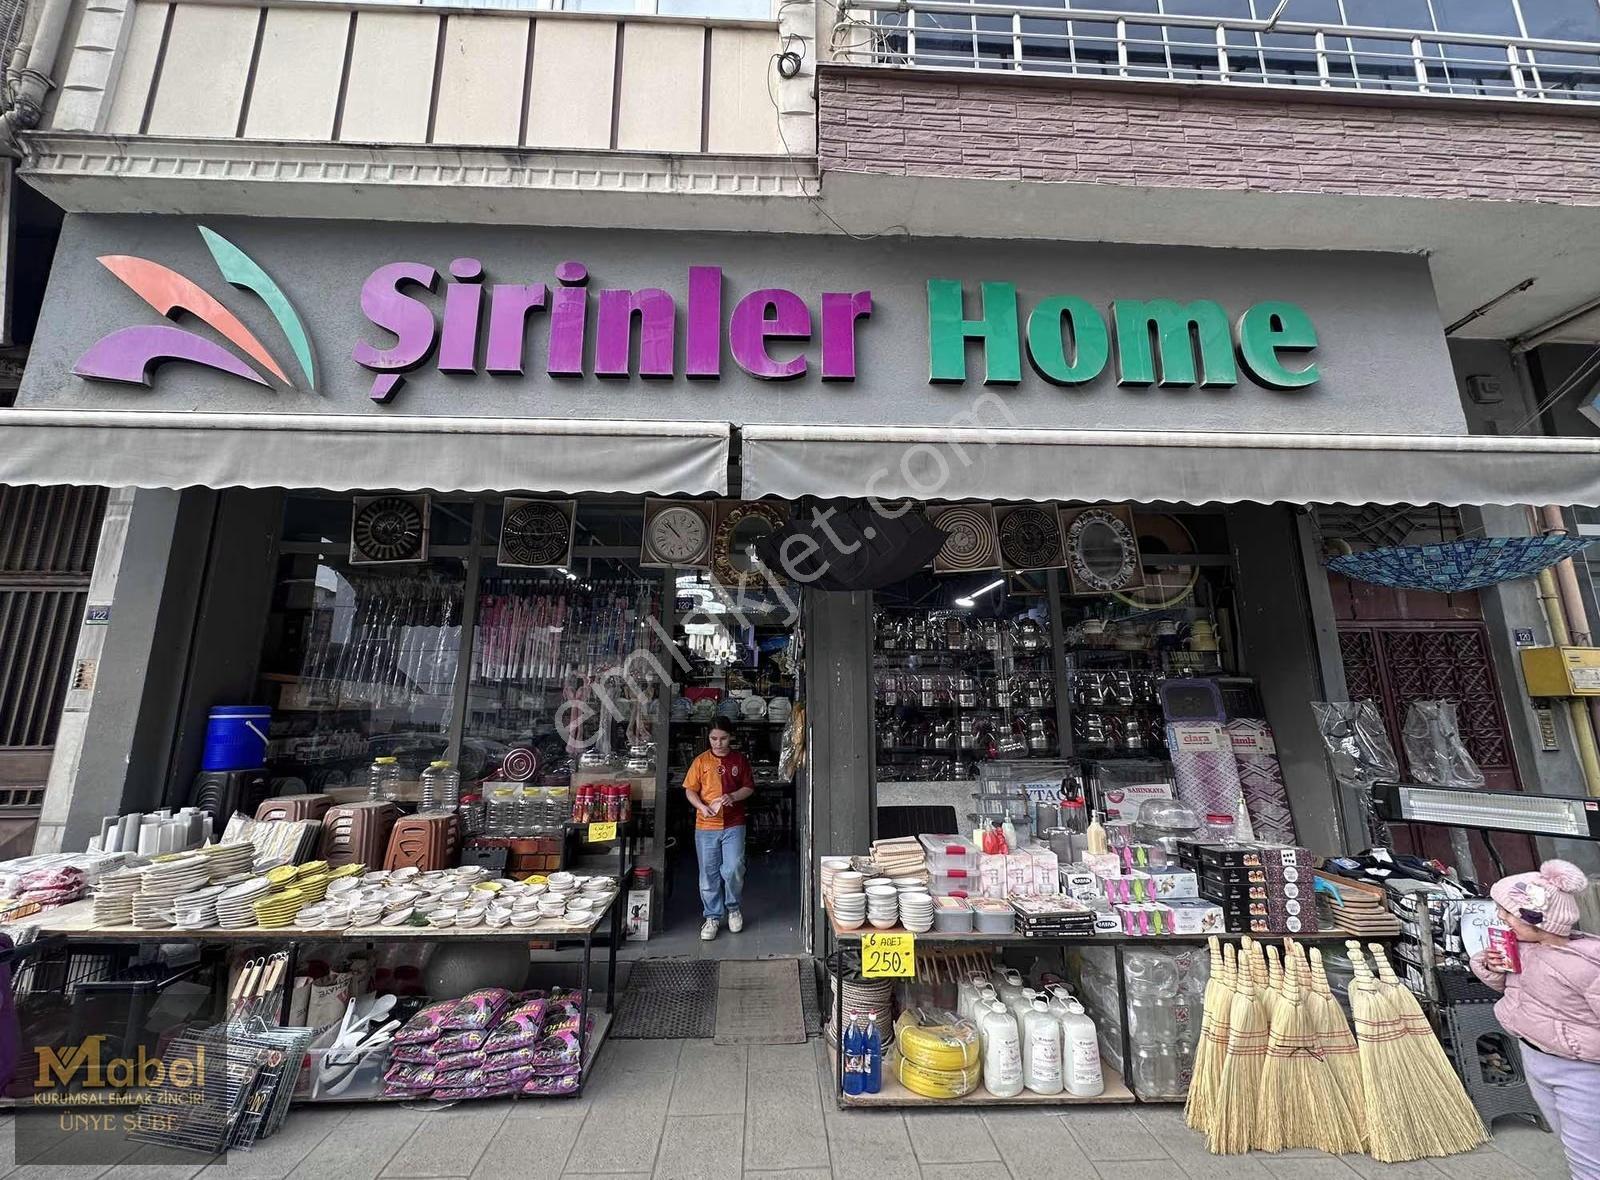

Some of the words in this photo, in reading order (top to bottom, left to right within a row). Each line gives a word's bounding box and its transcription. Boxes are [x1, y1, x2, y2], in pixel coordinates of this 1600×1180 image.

[352, 257, 873, 403] Şirinler
[925, 279, 1323, 391] Home
[92, 609, 106, 620] 122
[870, 933, 877, 946] 6
